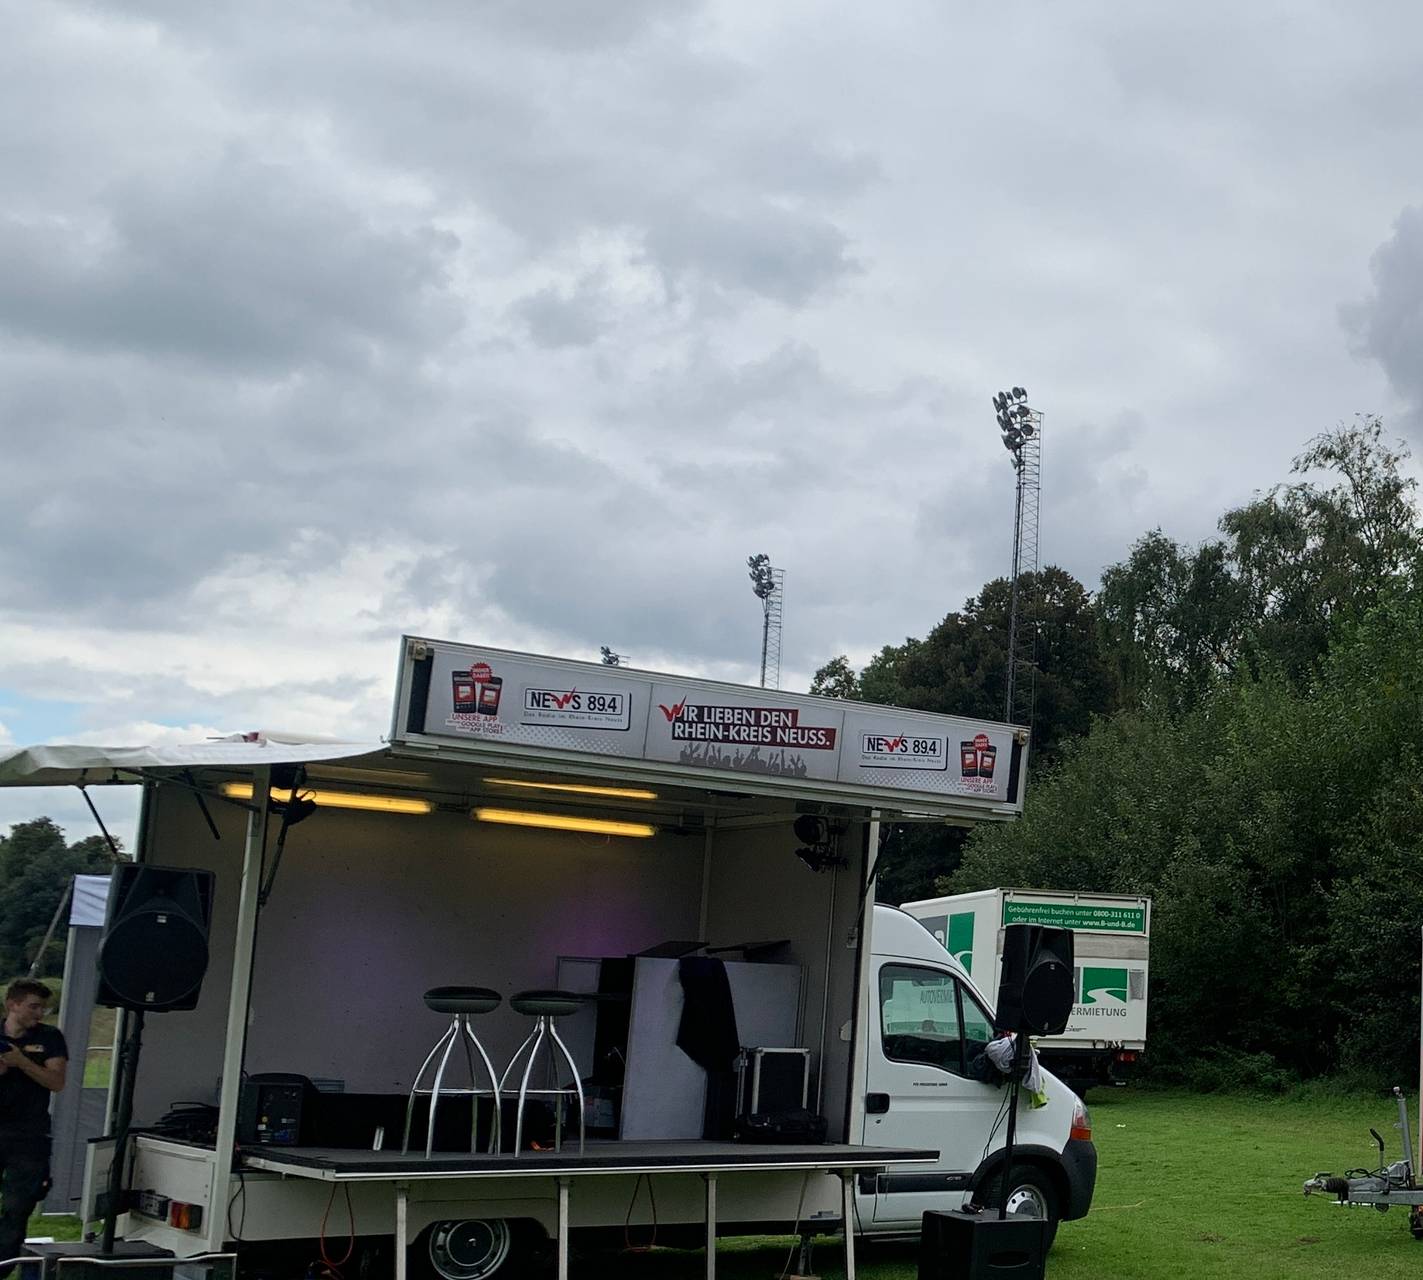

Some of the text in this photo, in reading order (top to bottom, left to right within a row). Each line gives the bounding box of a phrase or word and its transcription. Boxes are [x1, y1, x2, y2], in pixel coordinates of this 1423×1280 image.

[531, 687, 617, 712] NEWS 89.4
[658, 695, 792, 727] WIR LIEBEN DEN
[674, 722, 831, 746] RHEIN-KREIS NEUSS.
[867, 733, 937, 754] NEWS 89.4
[1008, 905, 1050, 915] Gebührenfrei
[1051, 908, 1075, 916] buchen
[1038, 917, 1064, 925] Internet
[1071, 1007, 1127, 1017] ERMIETUNG
